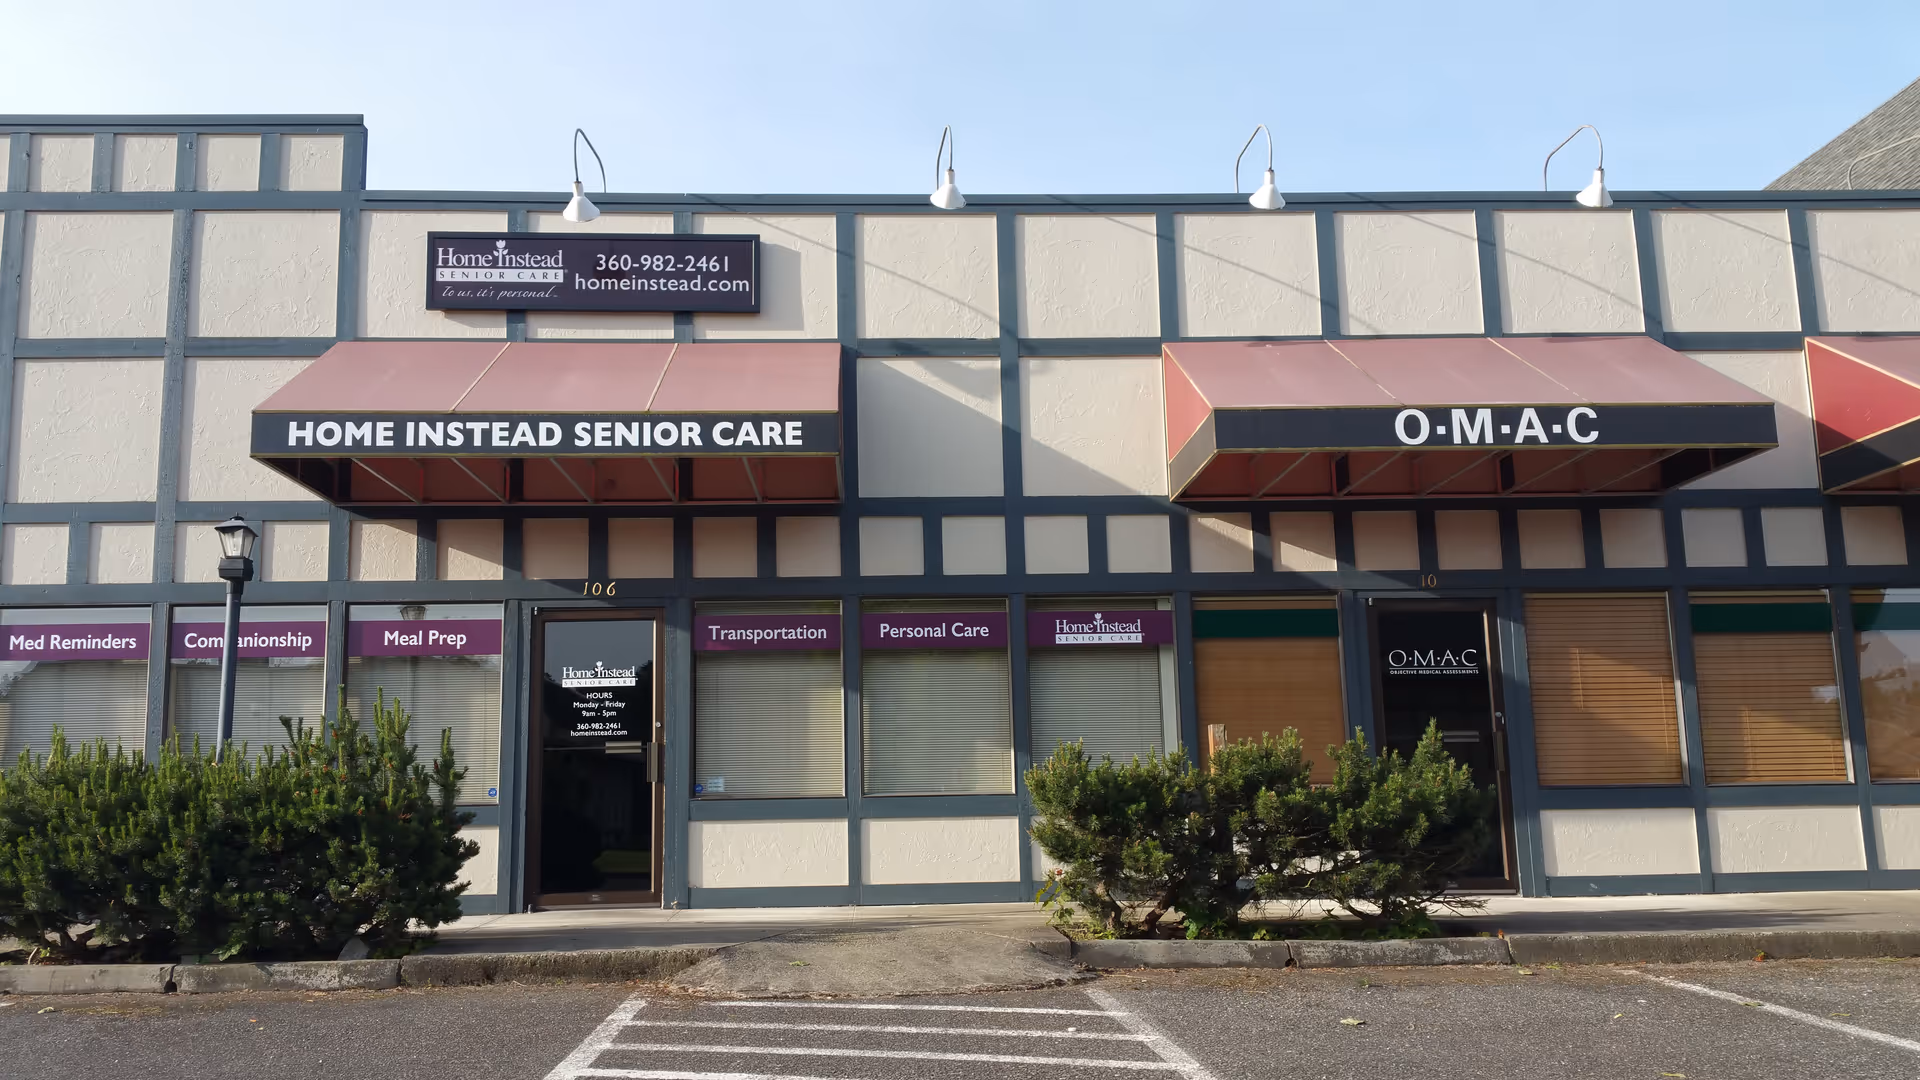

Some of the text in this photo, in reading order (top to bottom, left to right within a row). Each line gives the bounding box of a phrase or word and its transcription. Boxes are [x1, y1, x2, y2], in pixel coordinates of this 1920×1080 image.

[436, 247, 564, 268] Home Instead
[596, 254, 730, 273] 360-982-2461
[439, 270, 560, 281] SENIOR CARE
[575, 272, 750, 292] homeinstead.com
[442, 285, 455, 297] To
[287, 421, 803, 447] HOME INSTEAD SENIOR CARE
[583, 581, 616, 596] 106
[1421, 573, 1437, 588] 10
[708, 624, 828, 644] Transportation
[879, 622, 990, 639] Personal Care
[1055, 618, 1142, 634] Home Instead
[9, 633, 137, 651] Med Reminders
[183, 631, 313, 652] Comanionship
[383, 629, 467, 650] Meal Prep
[562, 665, 636, 679] Home Instead
[573, 701, 599, 709] Monday
[605, 700, 626, 708] Friday
[602, 709, 617, 718] 5pm
[570, 729, 628, 737] homeinstead.com
[576, 722, 621, 730] 360-982-2461
